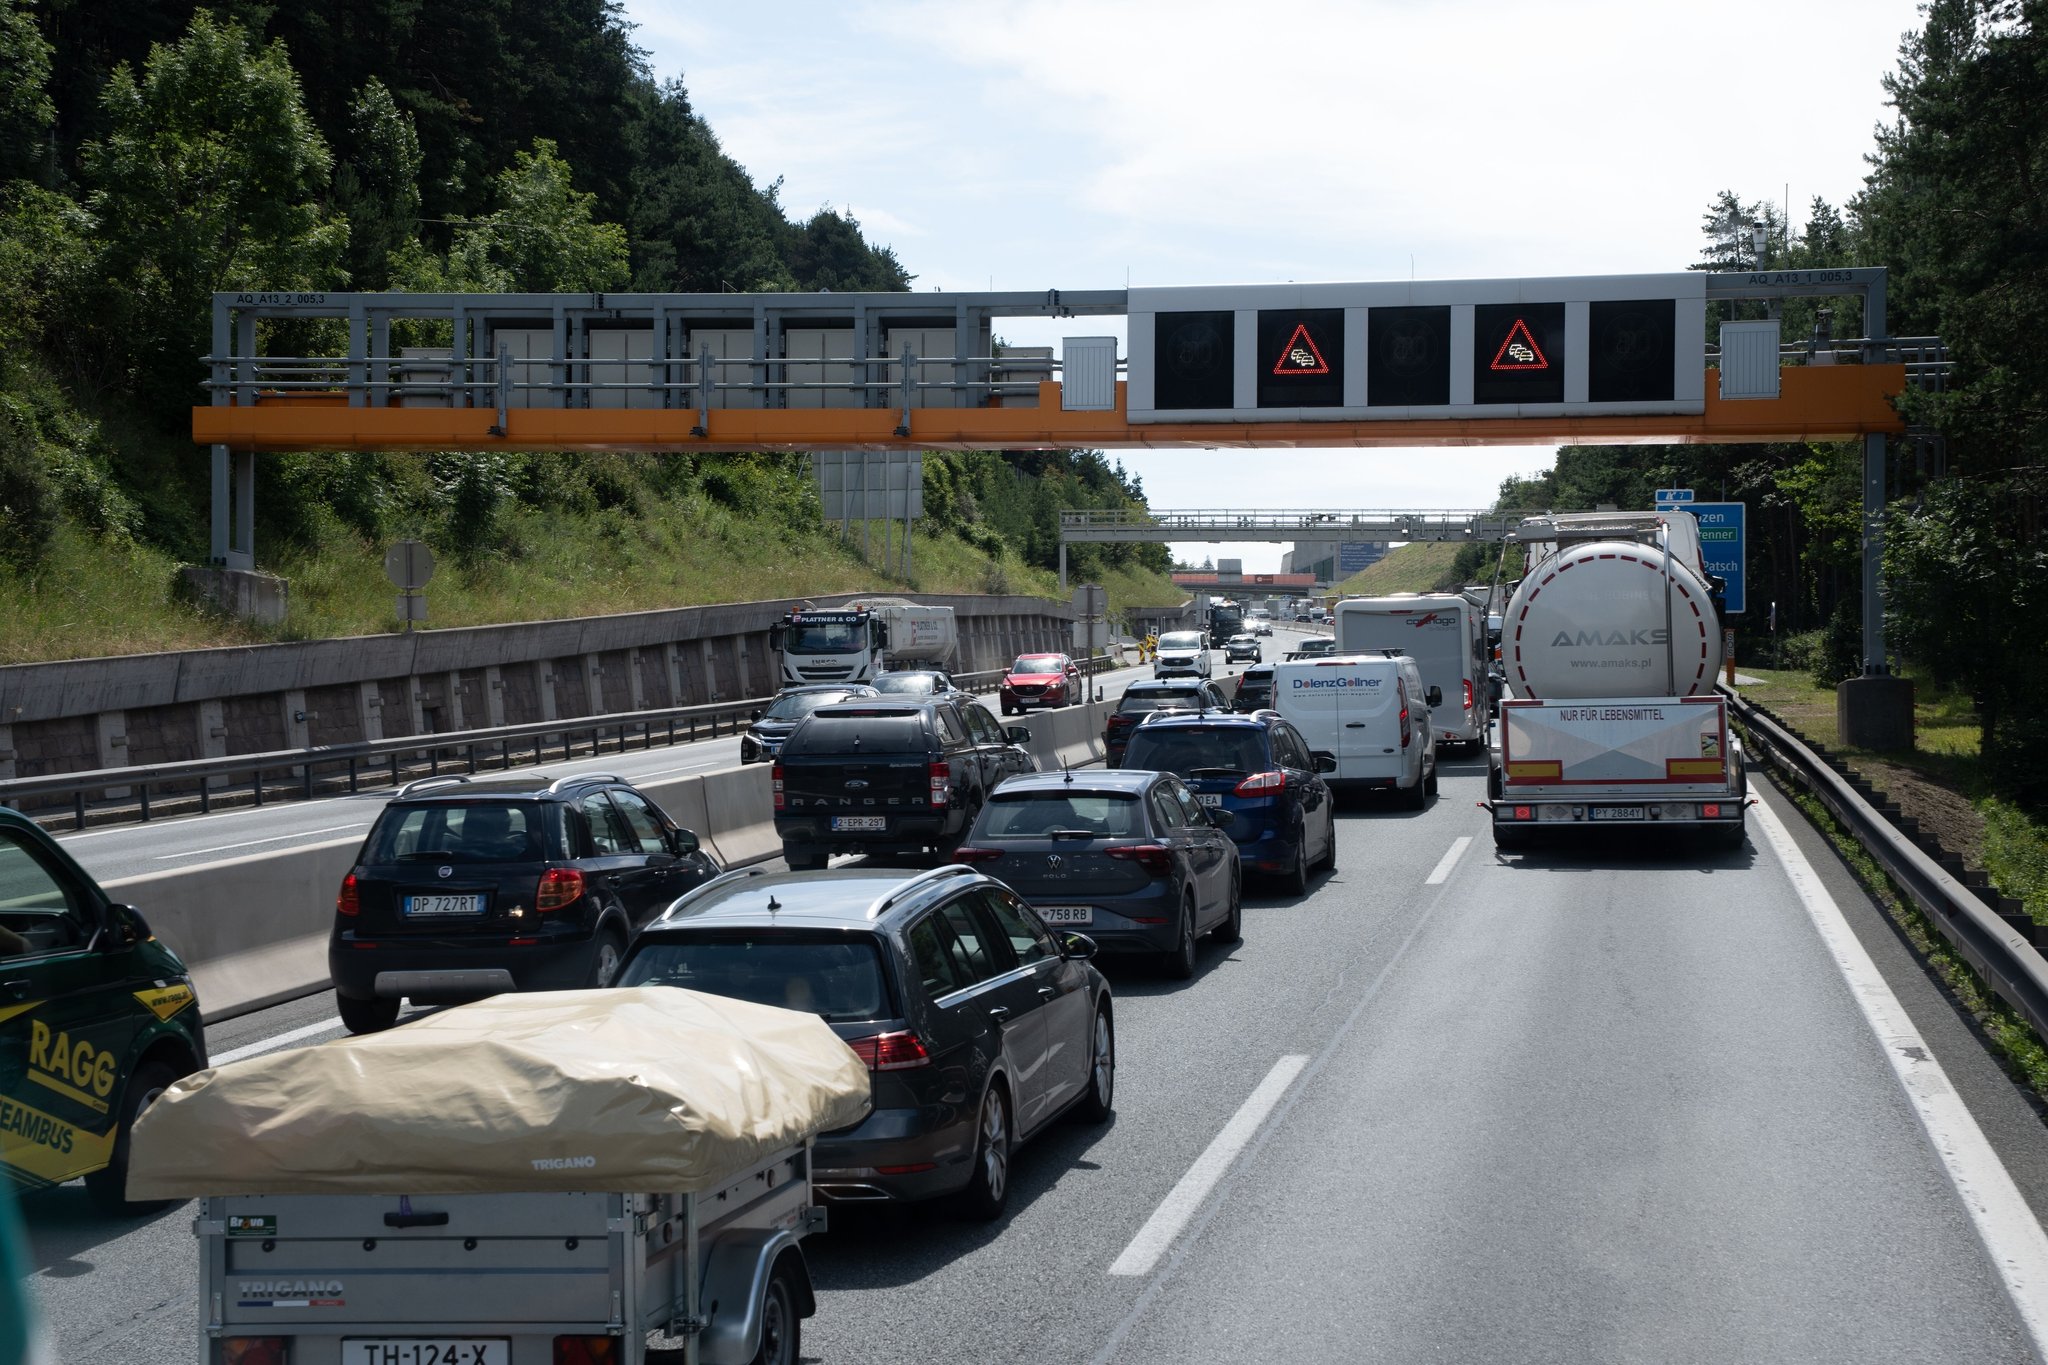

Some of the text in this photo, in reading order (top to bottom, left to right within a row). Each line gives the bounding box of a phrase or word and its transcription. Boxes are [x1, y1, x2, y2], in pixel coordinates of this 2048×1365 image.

[1749, 271, 1853, 286] AQ_A13_1_005,3
[237, 294, 325, 306] AQ_A13_2_005,3
[1704, 560, 1738, 572] Patsch
[1551, 628, 1669, 647] AMAKS
[1570, 658, 1652, 670] www.amaks.pl
[1560, 707, 1664, 721] NUR FÜR LEBENSMITTEL
[791, 797, 924, 806] RANGER
[1049, 908, 1071, 921] 758
[1073, 908, 1087, 921] RB
[29, 1019, 116, 1097] RAGG
[0, 1098, 73, 1154] EAMBUS
[531, 1155, 596, 1171] TRIGANO
[238, 1280, 344, 1299] TRIGANO
[364, 1344, 488, 1365] TH-124-X
